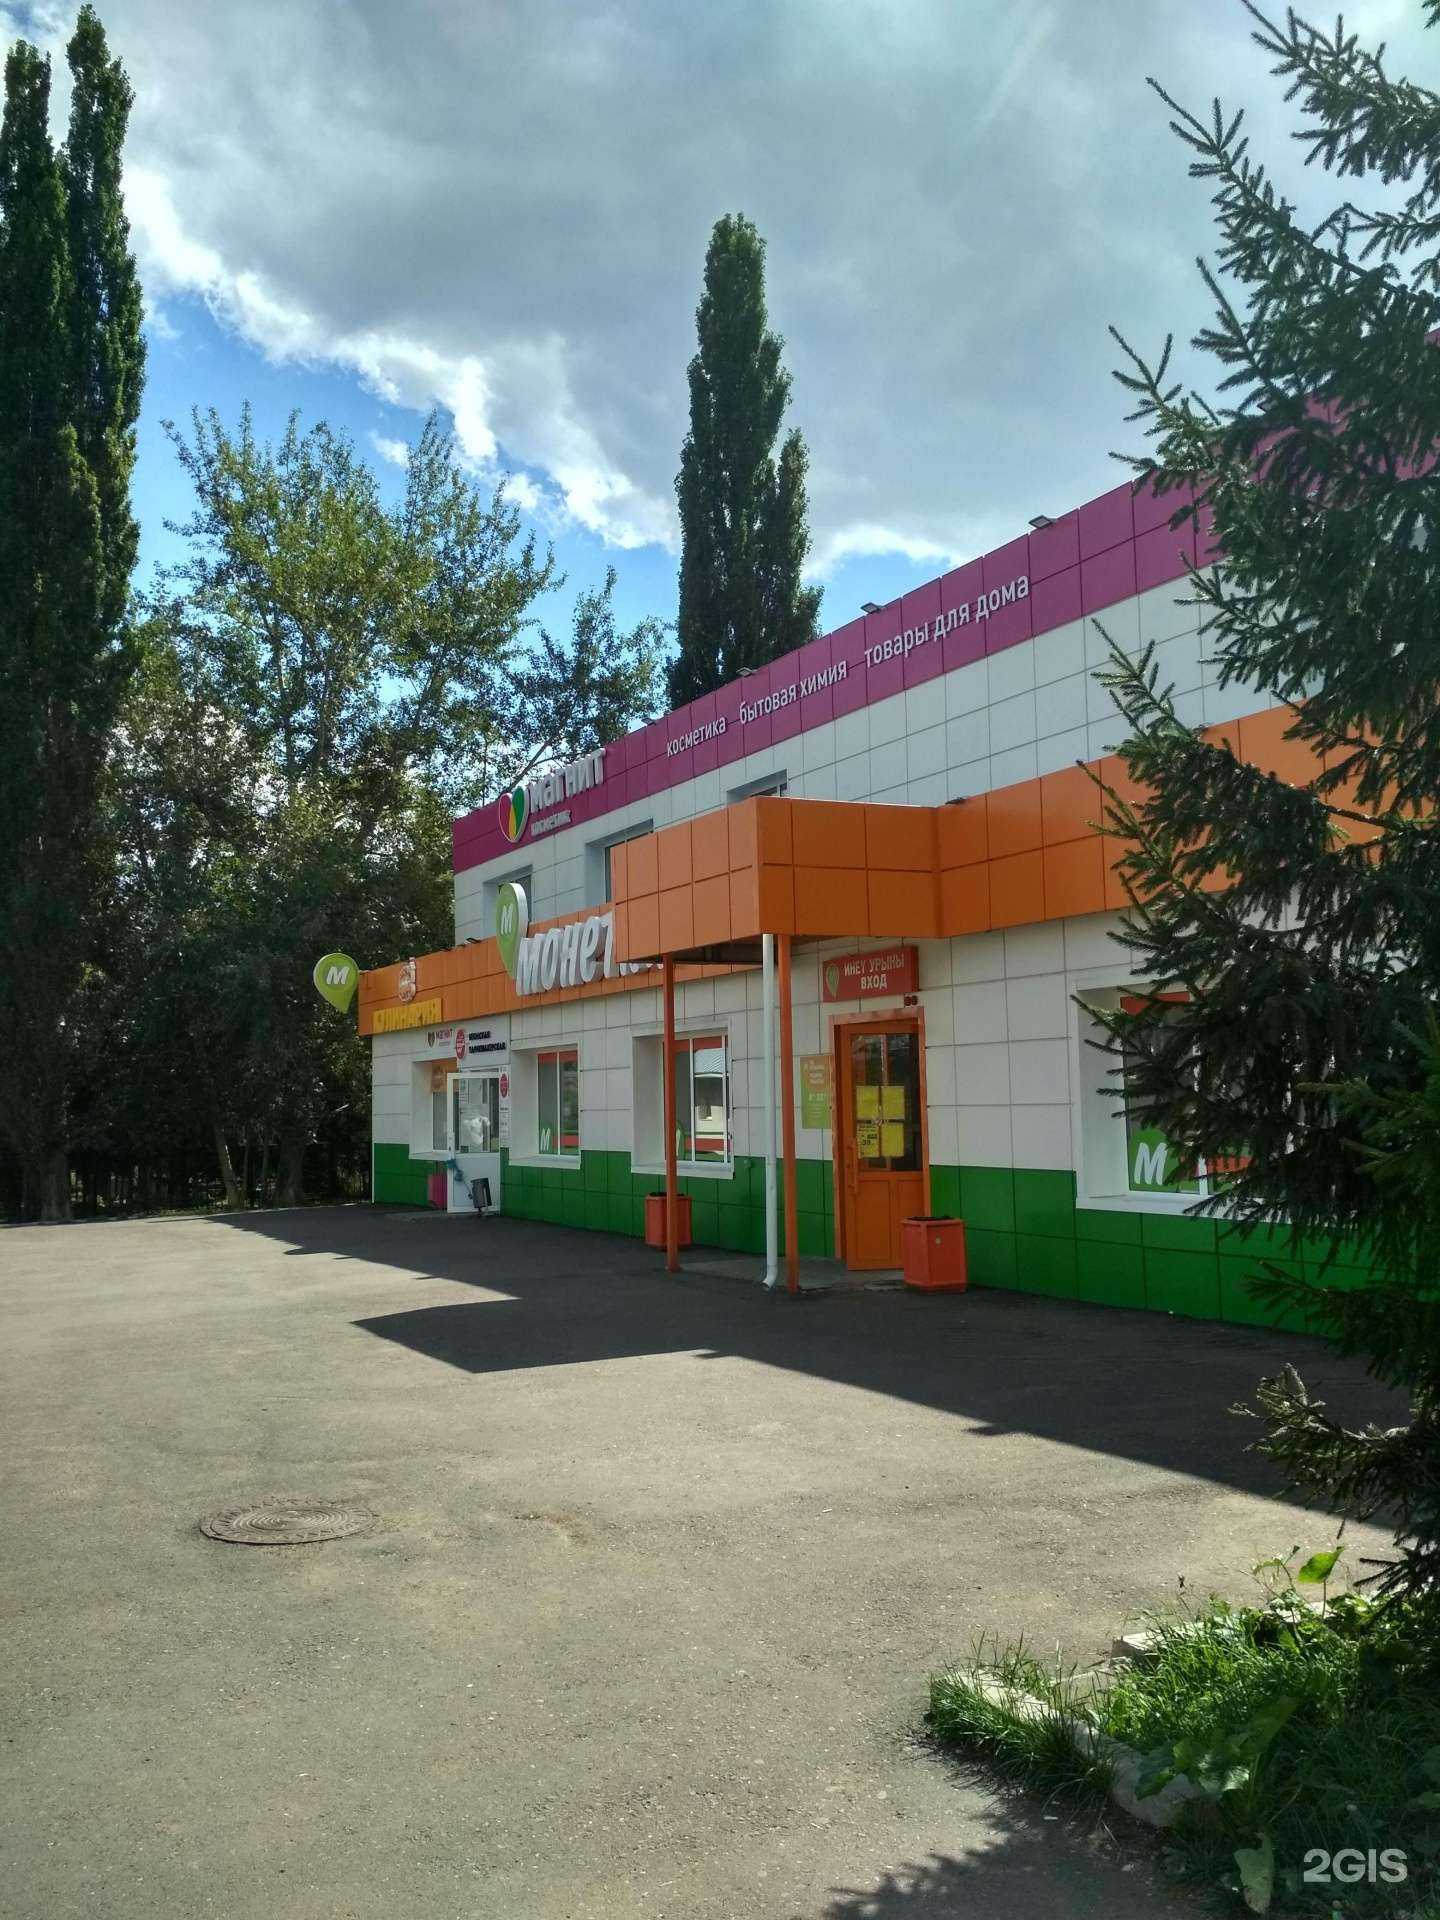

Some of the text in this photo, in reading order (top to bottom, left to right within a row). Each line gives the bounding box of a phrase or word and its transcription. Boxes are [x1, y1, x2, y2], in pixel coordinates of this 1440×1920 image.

[666, 575, 1030, 757] косметика бытовая химия товары для дома
[860, 973, 888, 990] ВХОД
